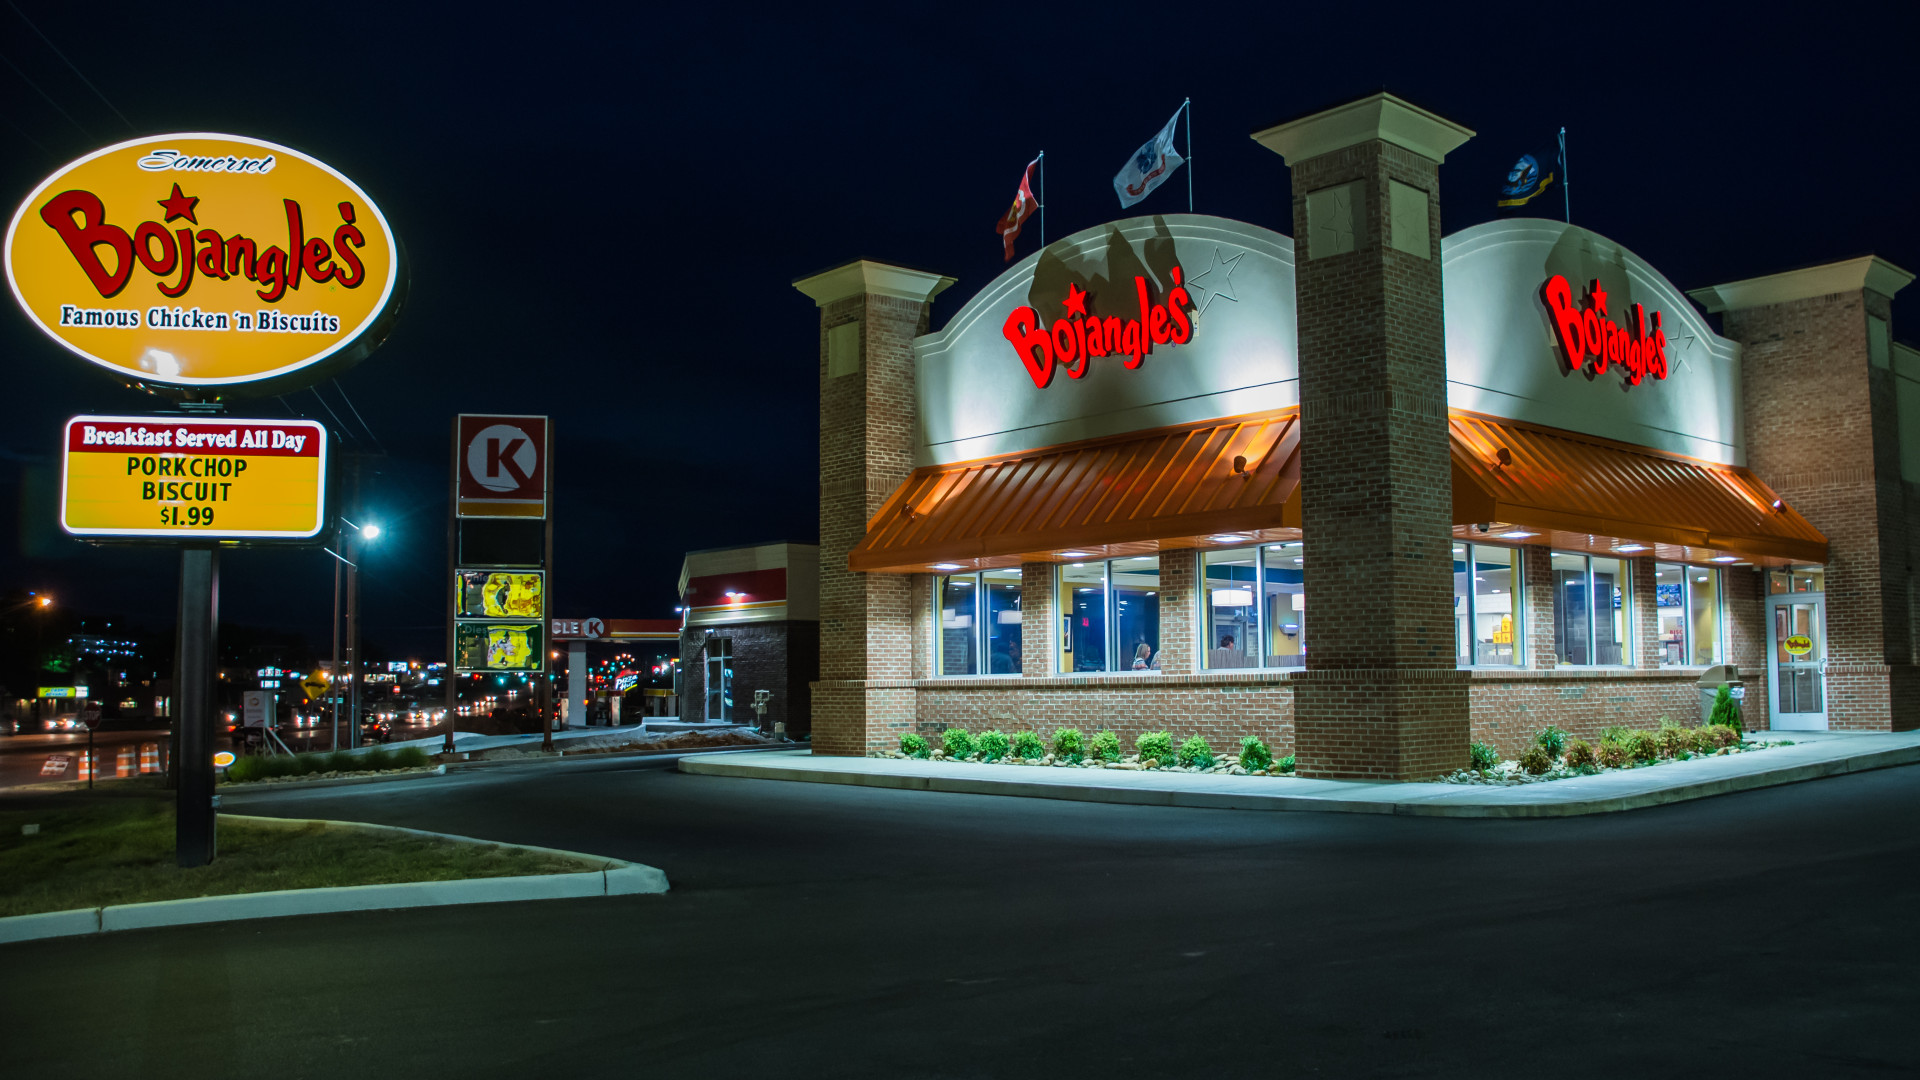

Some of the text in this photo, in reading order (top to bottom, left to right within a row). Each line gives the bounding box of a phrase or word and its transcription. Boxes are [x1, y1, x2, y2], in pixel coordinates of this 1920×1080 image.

[137, 150, 276, 175] Somerset
[40, 183, 365, 303] Bojangle's
[60, 305, 140, 329] Famous
[147, 307, 229, 330] Chicken
[257, 311, 340, 333] Biscuits
[1003, 267, 1191, 389] Bojangle's
[1542, 275, 1668, 387] Bojangle's
[83, 426, 306, 452] Breakfast Served All Day
[486, 438, 528, 481] K
[142, 481, 232, 502] BISCUIT
[160, 507, 215, 526] $1.99
[84, 710, 101, 721] STOP
